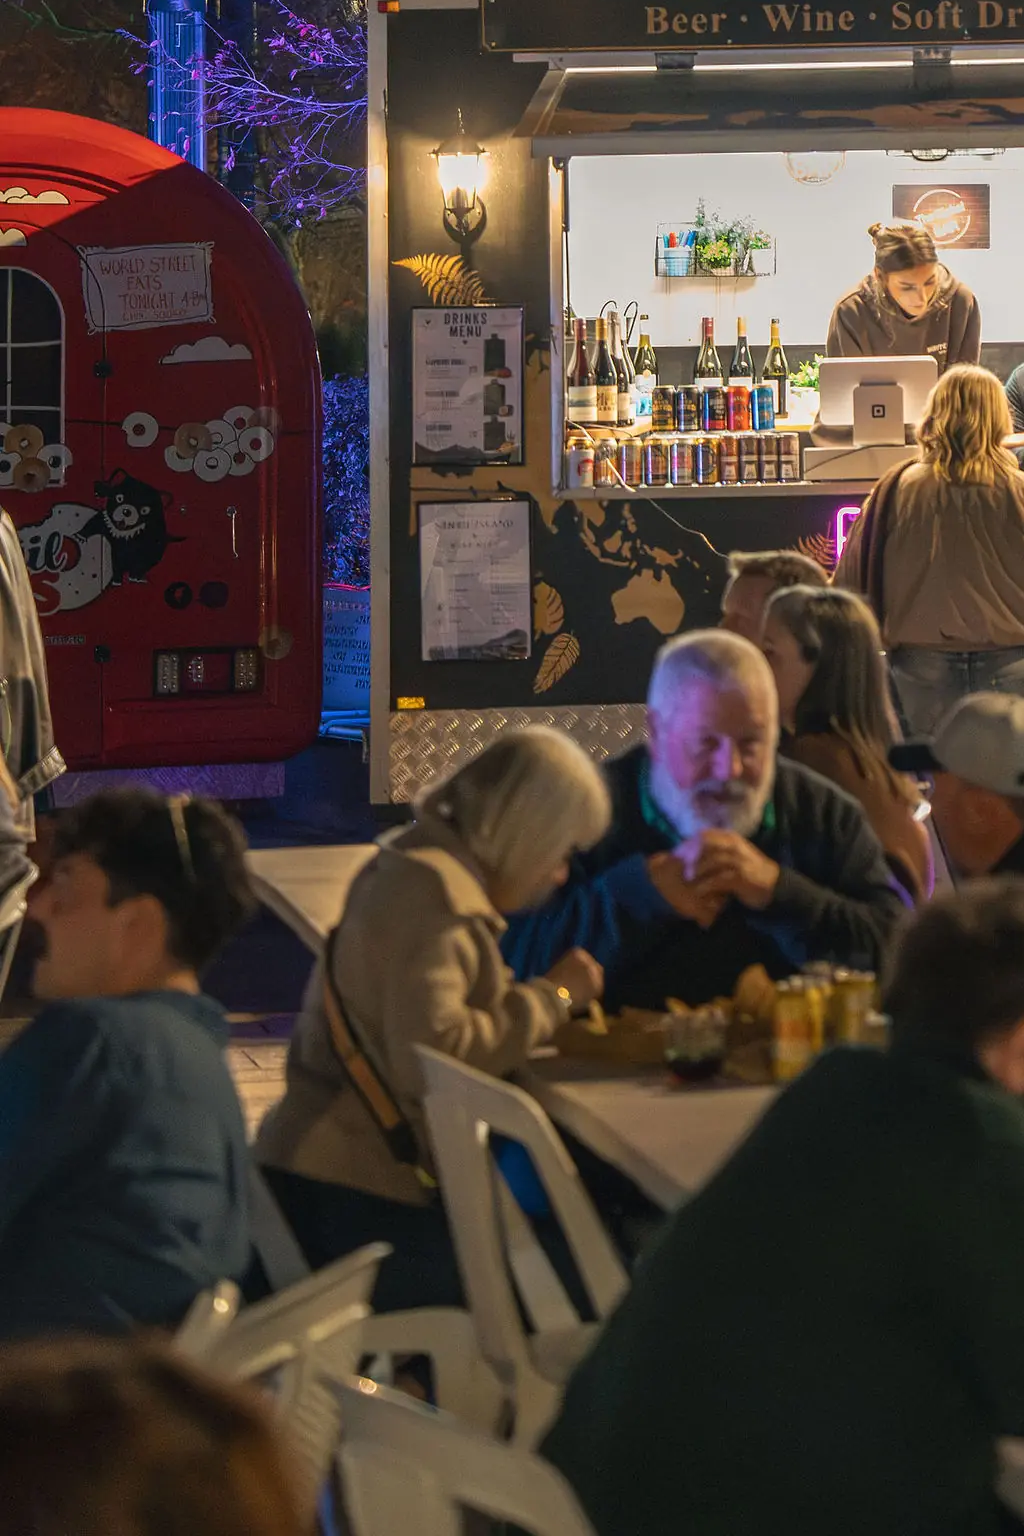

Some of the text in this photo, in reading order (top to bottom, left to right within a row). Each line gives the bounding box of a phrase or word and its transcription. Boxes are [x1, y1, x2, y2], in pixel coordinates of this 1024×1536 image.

[644, 5, 727, 34] Beer
[762, 3, 856, 32] Wine
[892, 0, 963, 31] Soft
[443, 312, 488, 325] DRINKS
[449, 325, 482, 338] MENU
